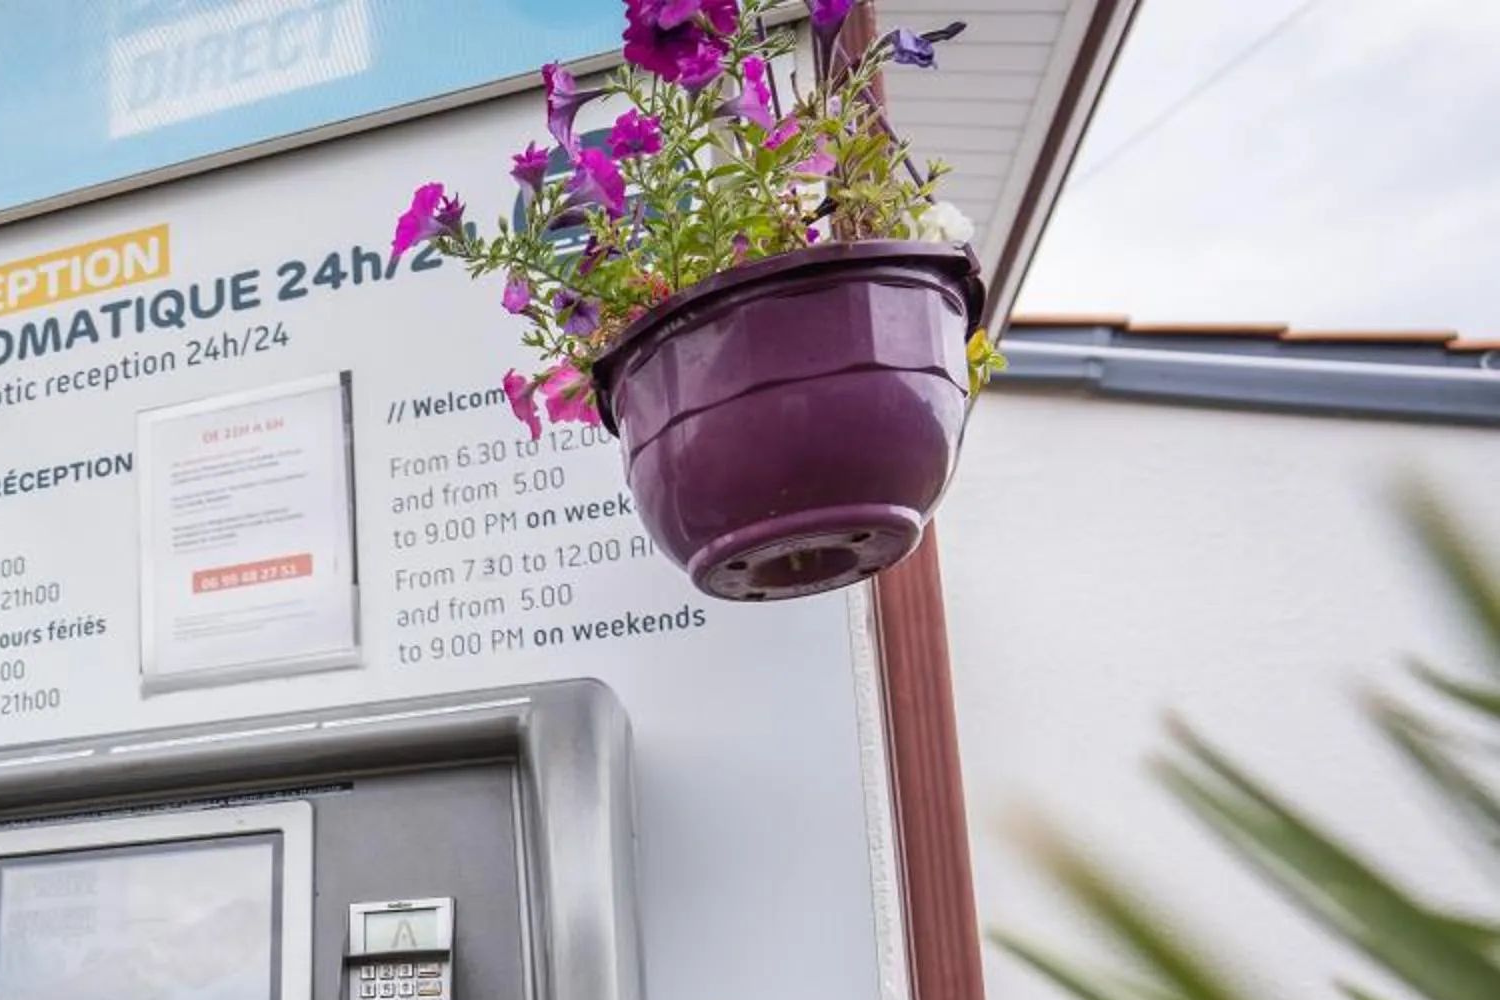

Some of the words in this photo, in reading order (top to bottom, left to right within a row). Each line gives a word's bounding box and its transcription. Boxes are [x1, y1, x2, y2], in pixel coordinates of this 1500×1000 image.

[276, 221, 477, 301] 24h/2
[45, 350, 175, 391] reception
[186, 321, 290, 366] 24h/24
[412, 386, 505, 418] Welcom
[390, 452, 448, 479] From
[515, 438, 539, 458] to
[392, 489, 433, 513] and
[442, 478, 498, 506] from
[513, 465, 565, 495] 5.00
[394, 529, 416, 549] to
[425, 516, 475, 545] 9.00
[485, 510, 518, 536] PM
[526, 510, 556, 528] on
[565, 493, 637, 523] week
[395, 564, 455, 591] From
[522, 551, 546, 574] to
[556, 539, 620, 569] 12.00
[630, 535, 654, 558] A
[0, 582, 61, 611] 21h00
[397, 600, 440, 627] and
[449, 596, 505, 622] from
[520, 583, 573, 611] 5.00
[47, 614, 107, 641] fériés
[399, 643, 422, 664] to
[430, 633, 482, 662] 9.00
[491, 627, 524, 652] PM
[533, 627, 564, 647] on
[572, 604, 707, 642] weekends
[0, 687, 61, 715] 21h00
